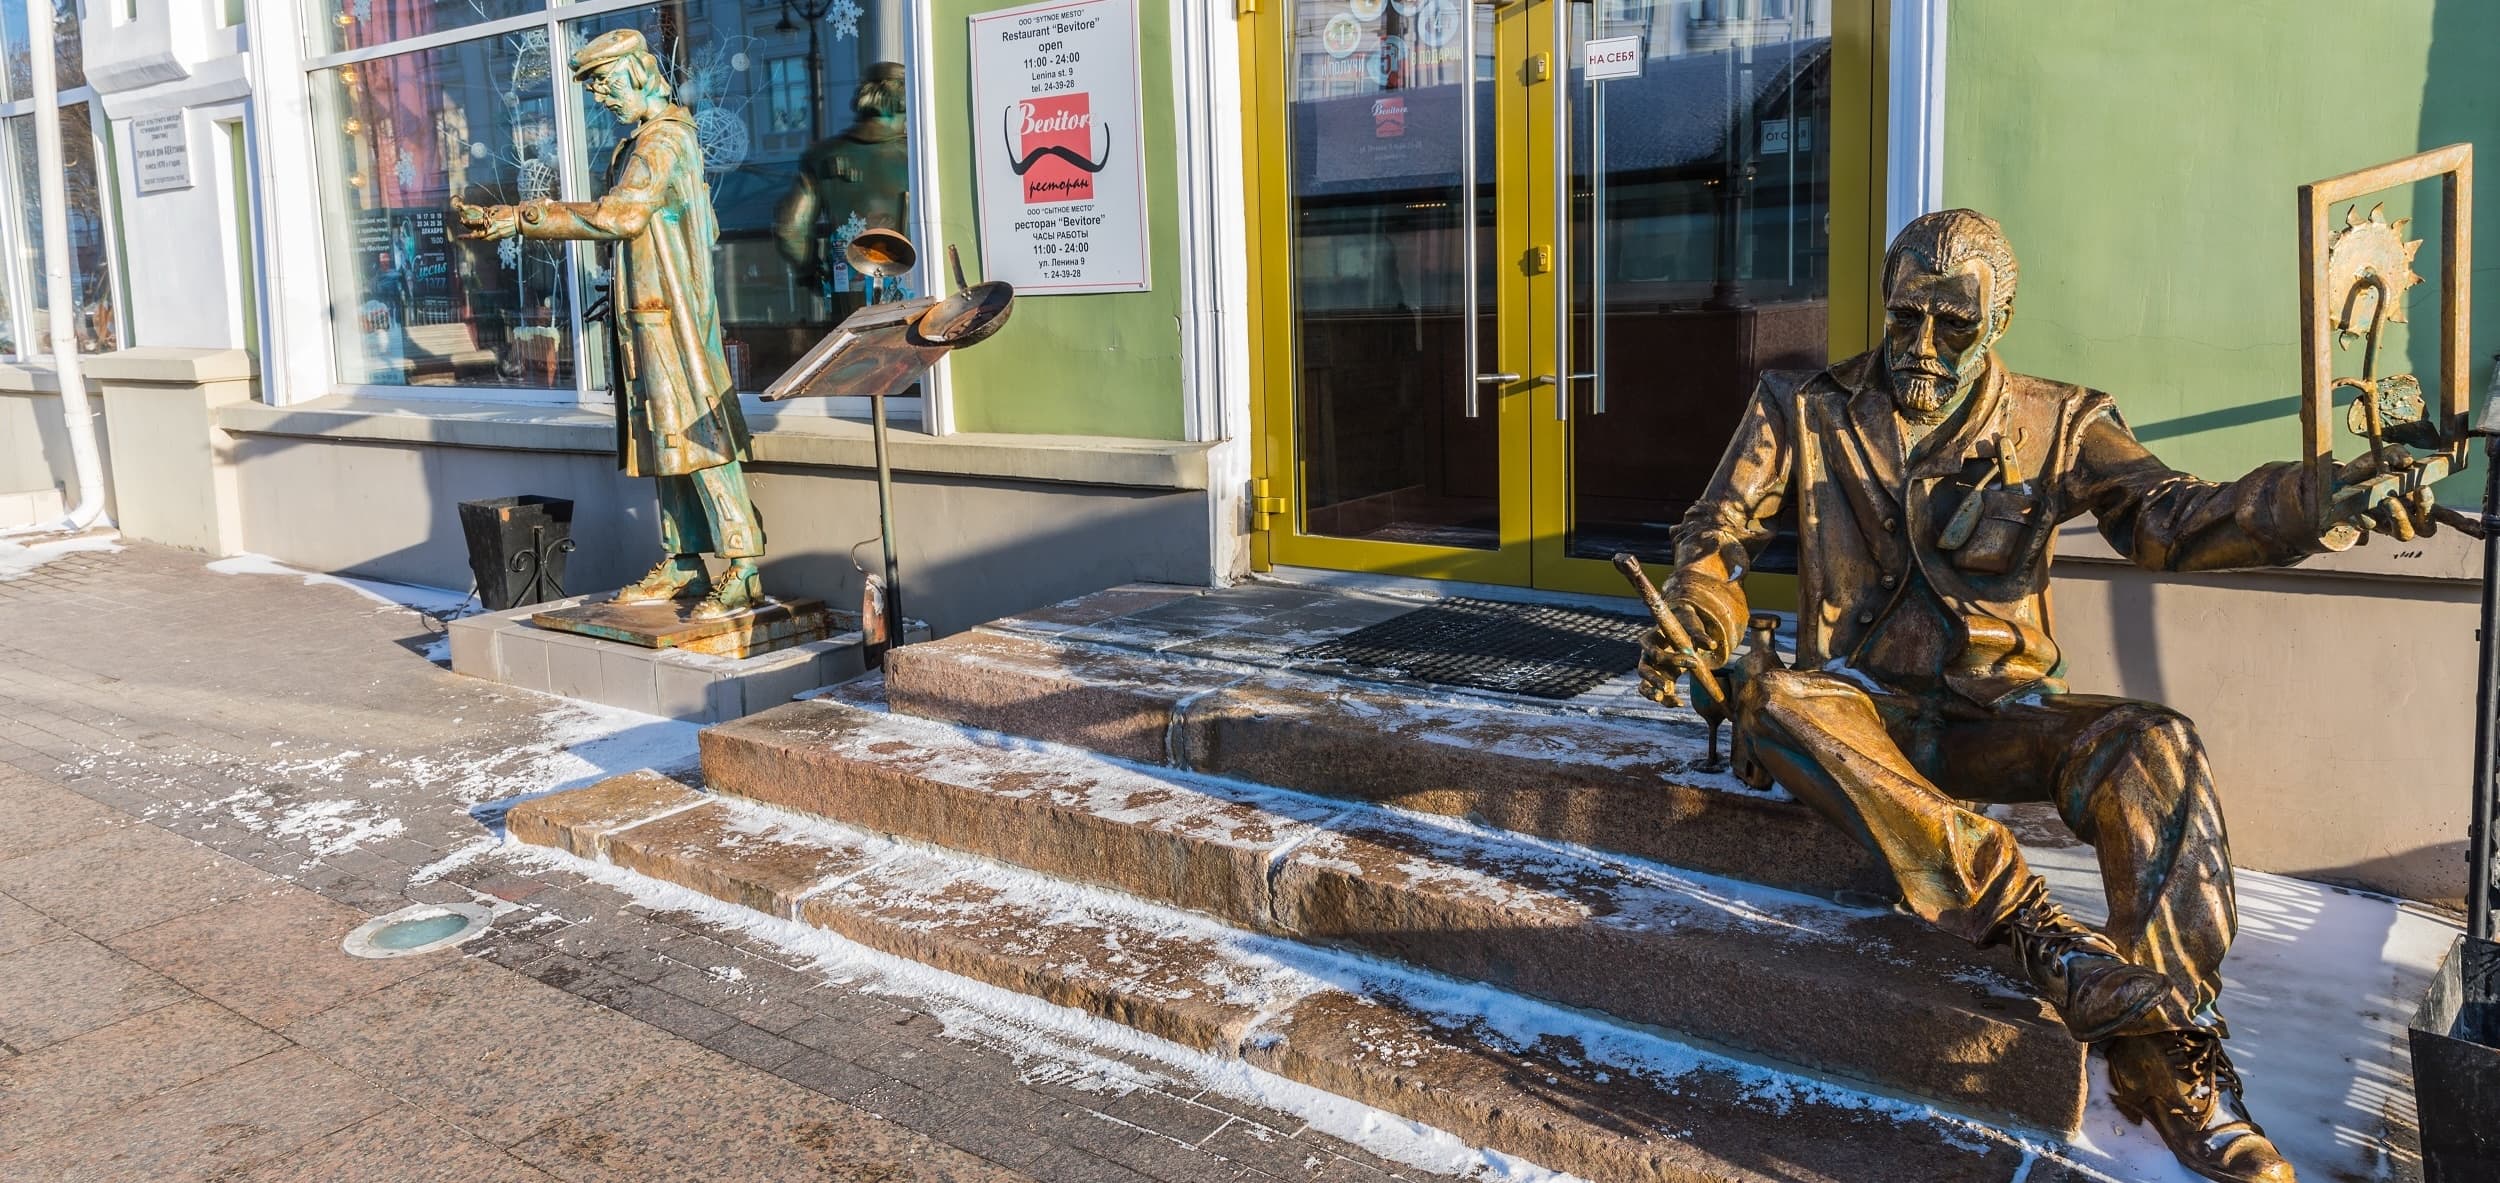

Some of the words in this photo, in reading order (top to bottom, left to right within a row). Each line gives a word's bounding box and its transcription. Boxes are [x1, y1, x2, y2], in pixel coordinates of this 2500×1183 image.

[1002, 26, 1050, 42] Restaurant
[1038, 40, 1063, 53] open
[1024, 56, 1047, 69] 11:00
[1055, 52, 1080, 65] 24:00
[1589, 55, 1605, 65] НА
[1606, 51, 1634, 63] СЕБЯ
[1031, 70, 1056, 81] Lenina
[1057, 69, 1067, 78] st.
[1068, 67, 1074, 76] 9
[1031, 84, 1043, 92] tel.
[1044, 80, 1075, 91] 24-39-28
[1029, 178, 1089, 199] ресторан
[1015, 219, 1056, 232] ресторан
[1033, 232, 1055, 241] ЧАСЫ
[1056, 230, 1089, 240] РАБОТЫ
[1033, 244, 1057, 255] 11:00
[1064, 242, 1089, 253] 24:00
[1038, 260, 1050, 269] ул.
[1051, 258, 1079, 267] Ленина
[1080, 257, 1085, 265] 9
[1051, 269, 1081, 279] 24-39-28
